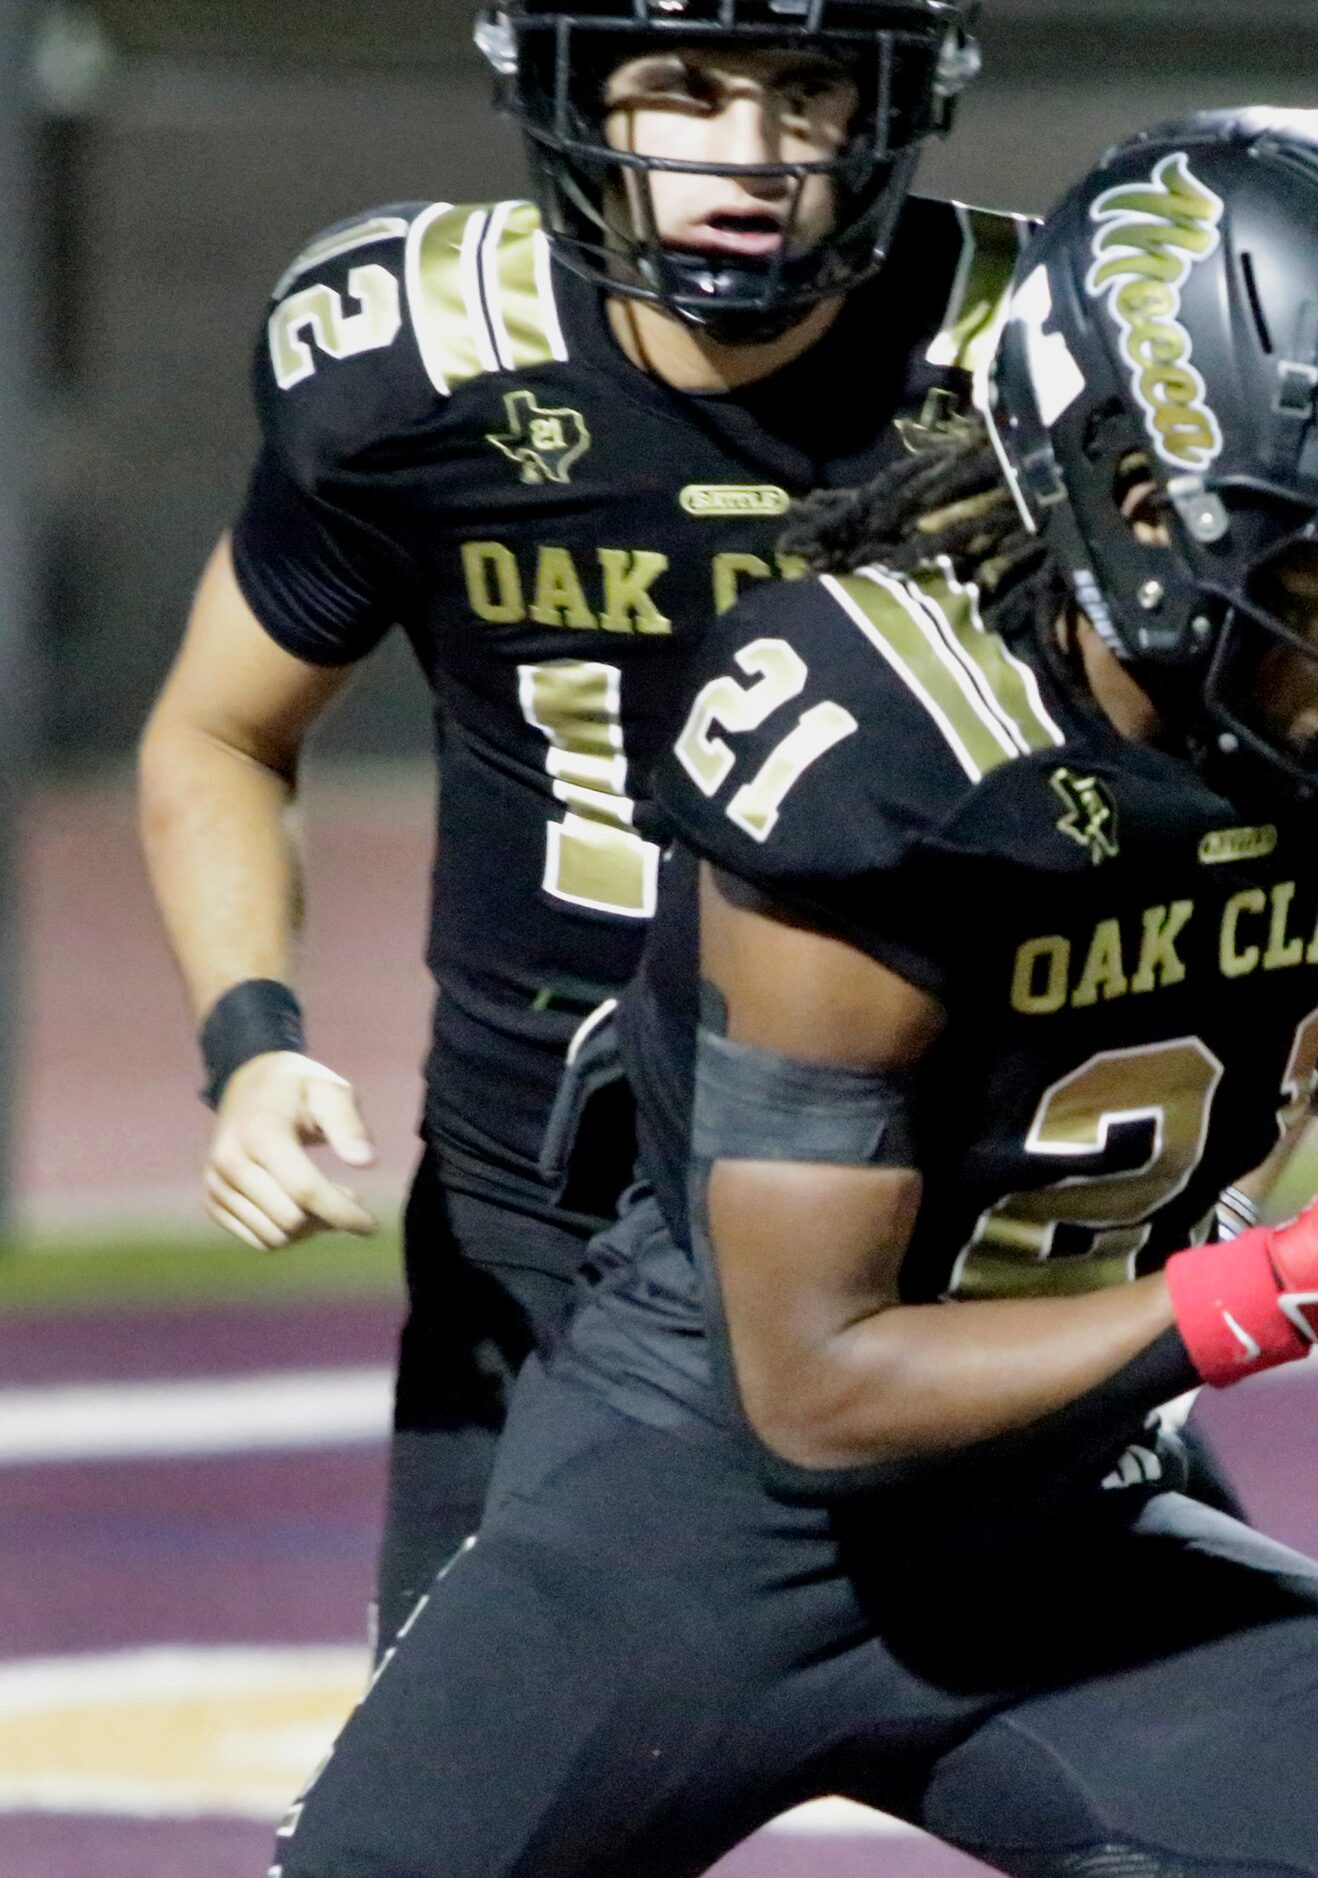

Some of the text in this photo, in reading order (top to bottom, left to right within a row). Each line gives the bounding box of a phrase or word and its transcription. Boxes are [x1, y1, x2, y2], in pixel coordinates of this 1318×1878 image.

[461, 541, 672, 634] OAK
[674, 638, 859, 843] 21
[1010, 900, 1194, 1015] OAK
